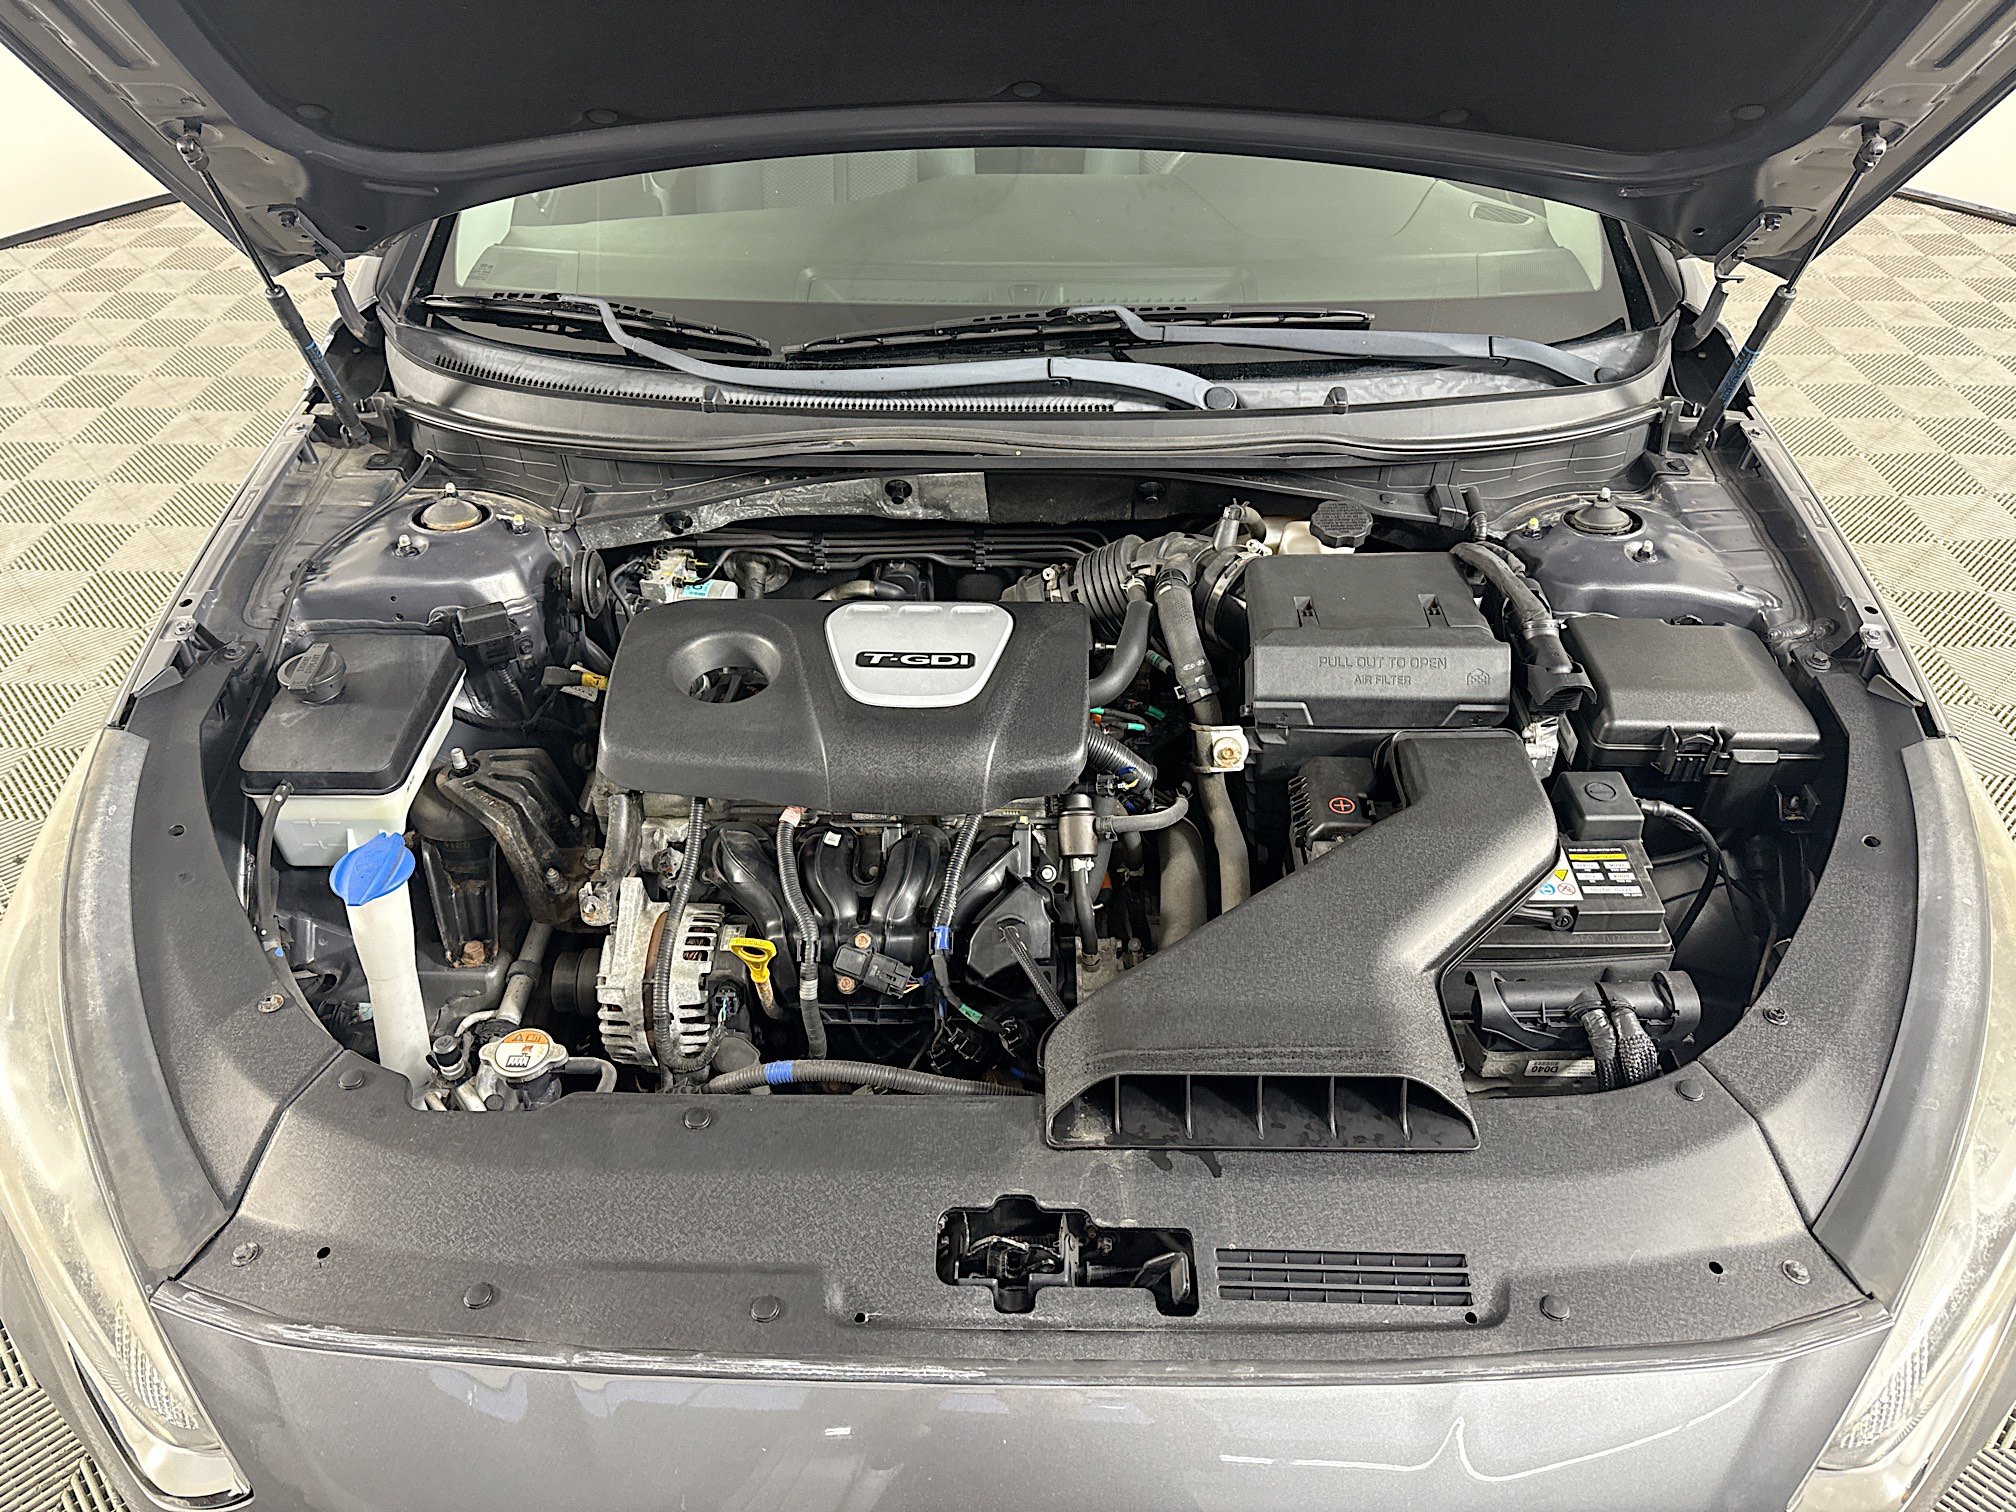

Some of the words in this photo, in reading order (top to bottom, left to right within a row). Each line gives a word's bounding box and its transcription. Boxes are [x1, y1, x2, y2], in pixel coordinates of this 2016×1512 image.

[863, 652, 969, 666] T-GDI
[1318, 655, 1353, 669] PULL
[1356, 655, 1385, 669] OUT
[1388, 656, 1406, 669] TO
[1409, 656, 1447, 670] OPEN
[1353, 674, 1372, 685] AIR
[1375, 674, 1411, 686] FILTER
[1531, 1065, 1559, 1074] D040
